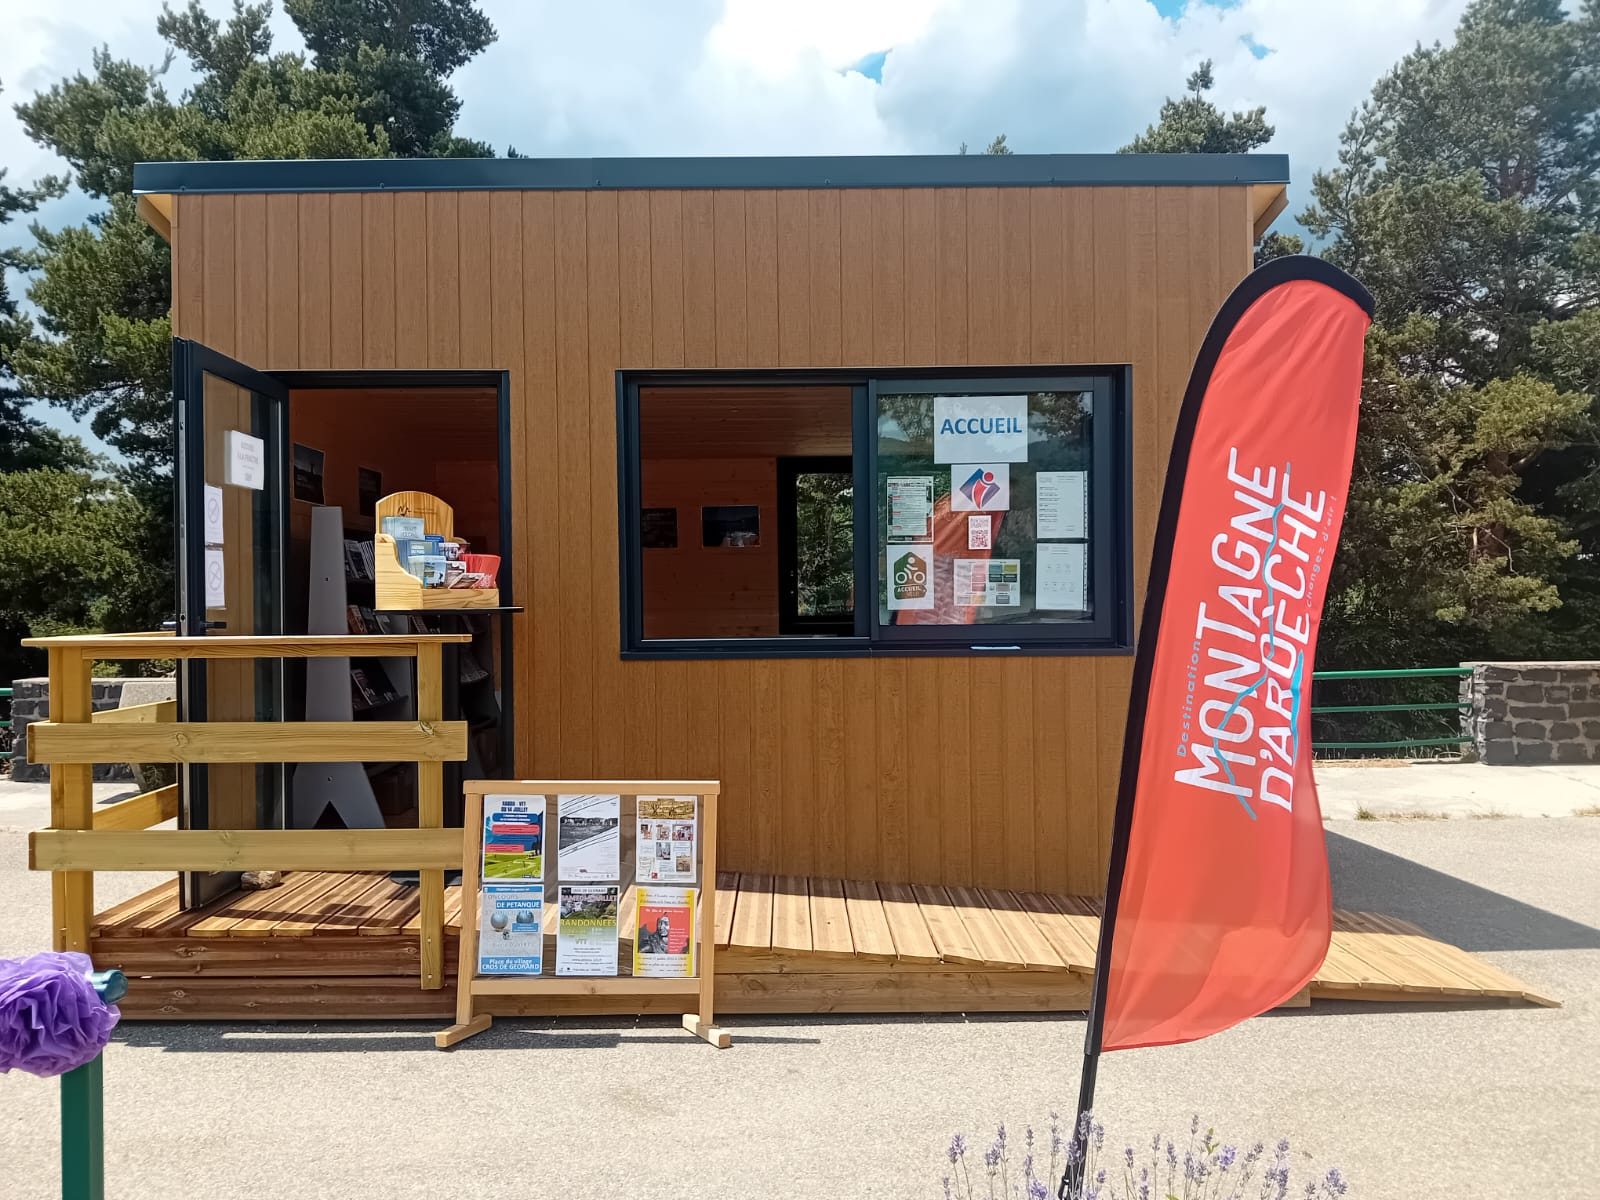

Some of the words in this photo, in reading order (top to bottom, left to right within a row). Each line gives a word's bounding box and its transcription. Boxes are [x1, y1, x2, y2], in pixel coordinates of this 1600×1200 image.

[940, 417, 1022, 434] ACCUEIL
[897, 585, 922, 593] ACCUEIL
[1174, 447, 1276, 798] MONTAGNE
[1177, 641, 1201, 757] Destination
